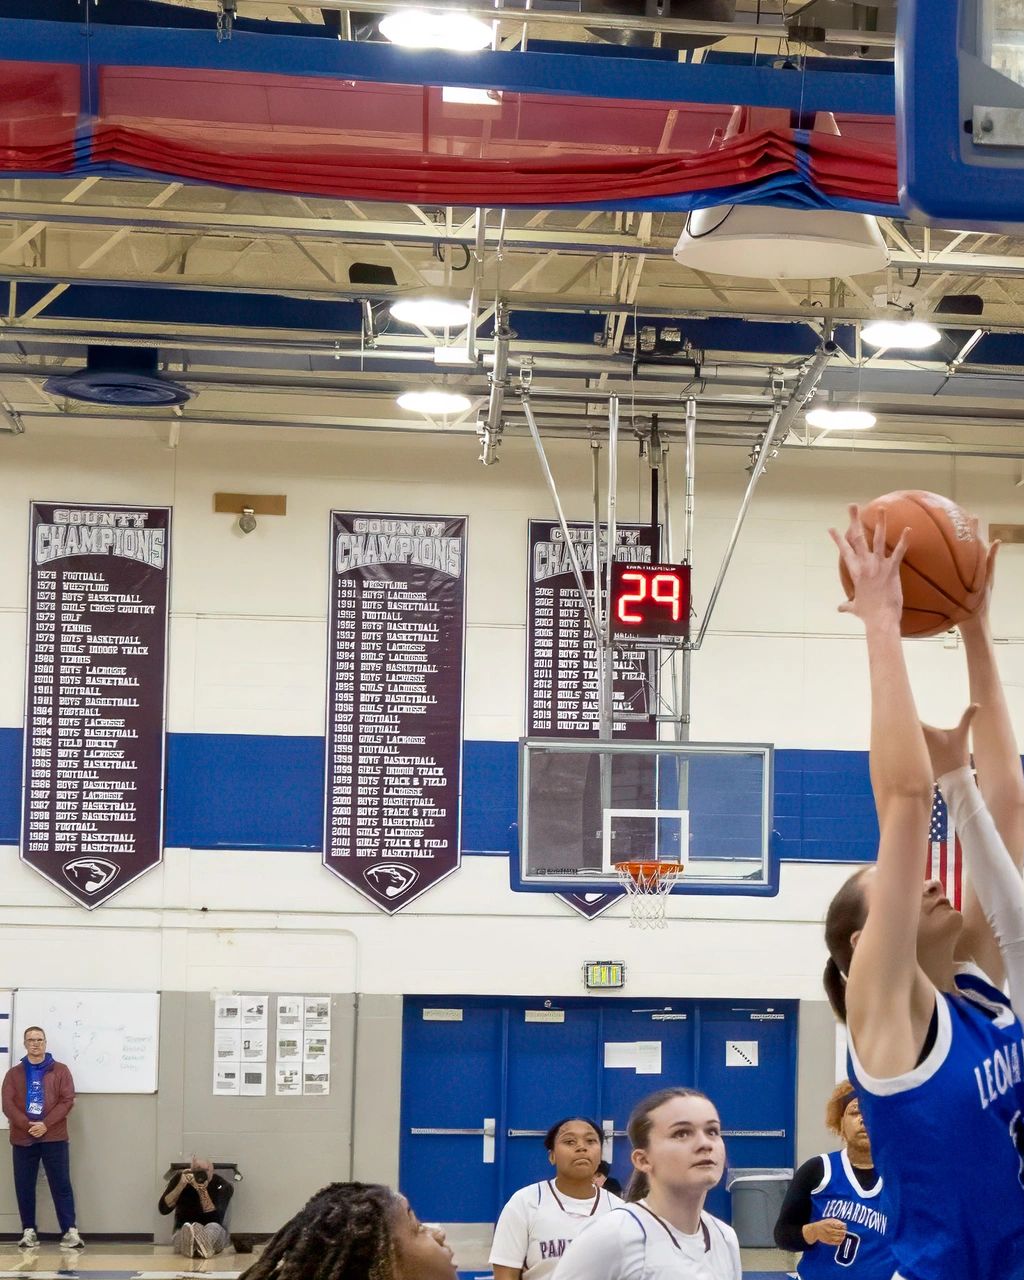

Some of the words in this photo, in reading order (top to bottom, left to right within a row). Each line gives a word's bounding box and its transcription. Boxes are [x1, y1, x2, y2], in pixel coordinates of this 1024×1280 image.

[53, 509, 148, 528] COUNTY
[353, 518, 445, 537] COUNTY
[35, 523, 165, 570] CHAMPIONS
[335, 532, 462, 579] CHAMPIONS
[63, 571, 105, 582] FOOTBALL
[88, 593, 143, 603] BASKETBALL
[618, 573, 680, 622] 29
[388, 601, 440, 612] BASKETBALL
[362, 611, 403, 621] FOOTBALL
[387, 622, 440, 632] BASKETBALL
[87, 635, 141, 645] BASKETBALL
[387, 632, 439, 642] BASKETBALL
[386, 663, 438, 673] BASKETBALL
[86, 676, 140, 686] BASKETBALL
[60, 686, 102, 696] FOOTBALL
[85, 697, 140, 707] BASKETBALL
[385, 694, 438, 704] BASKETBALL
[59, 707, 101, 717] FOOTBALL
[360, 714, 401, 724] FOOTBALL
[84, 728, 139, 738] BASKETBALL
[359, 724, 400, 734] FOOTBALL
[359, 745, 400, 754] FOOTBALL
[83, 760, 138, 770] BASKETBALL
[384, 756, 436, 766] BASKETBALL
[57, 769, 99, 779] FOOTBALL
[83, 780, 137, 791] BASKETBALL
[82, 801, 137, 811] BASKETBALL
[383, 797, 436, 807] BASKETBALL
[82, 812, 136, 822] BASKETBALL
[383, 817, 435, 827] BASKETBALL
[82, 833, 136, 843] BASKETBALL
[382, 848, 435, 859] BASKETBALL
[592, 965, 619, 985] EXIT
[822, 1199, 888, 1236] LEONARDTOWN
[539, 1238, 574, 1260] PAN
[834, 1231, 861, 1267] 0
